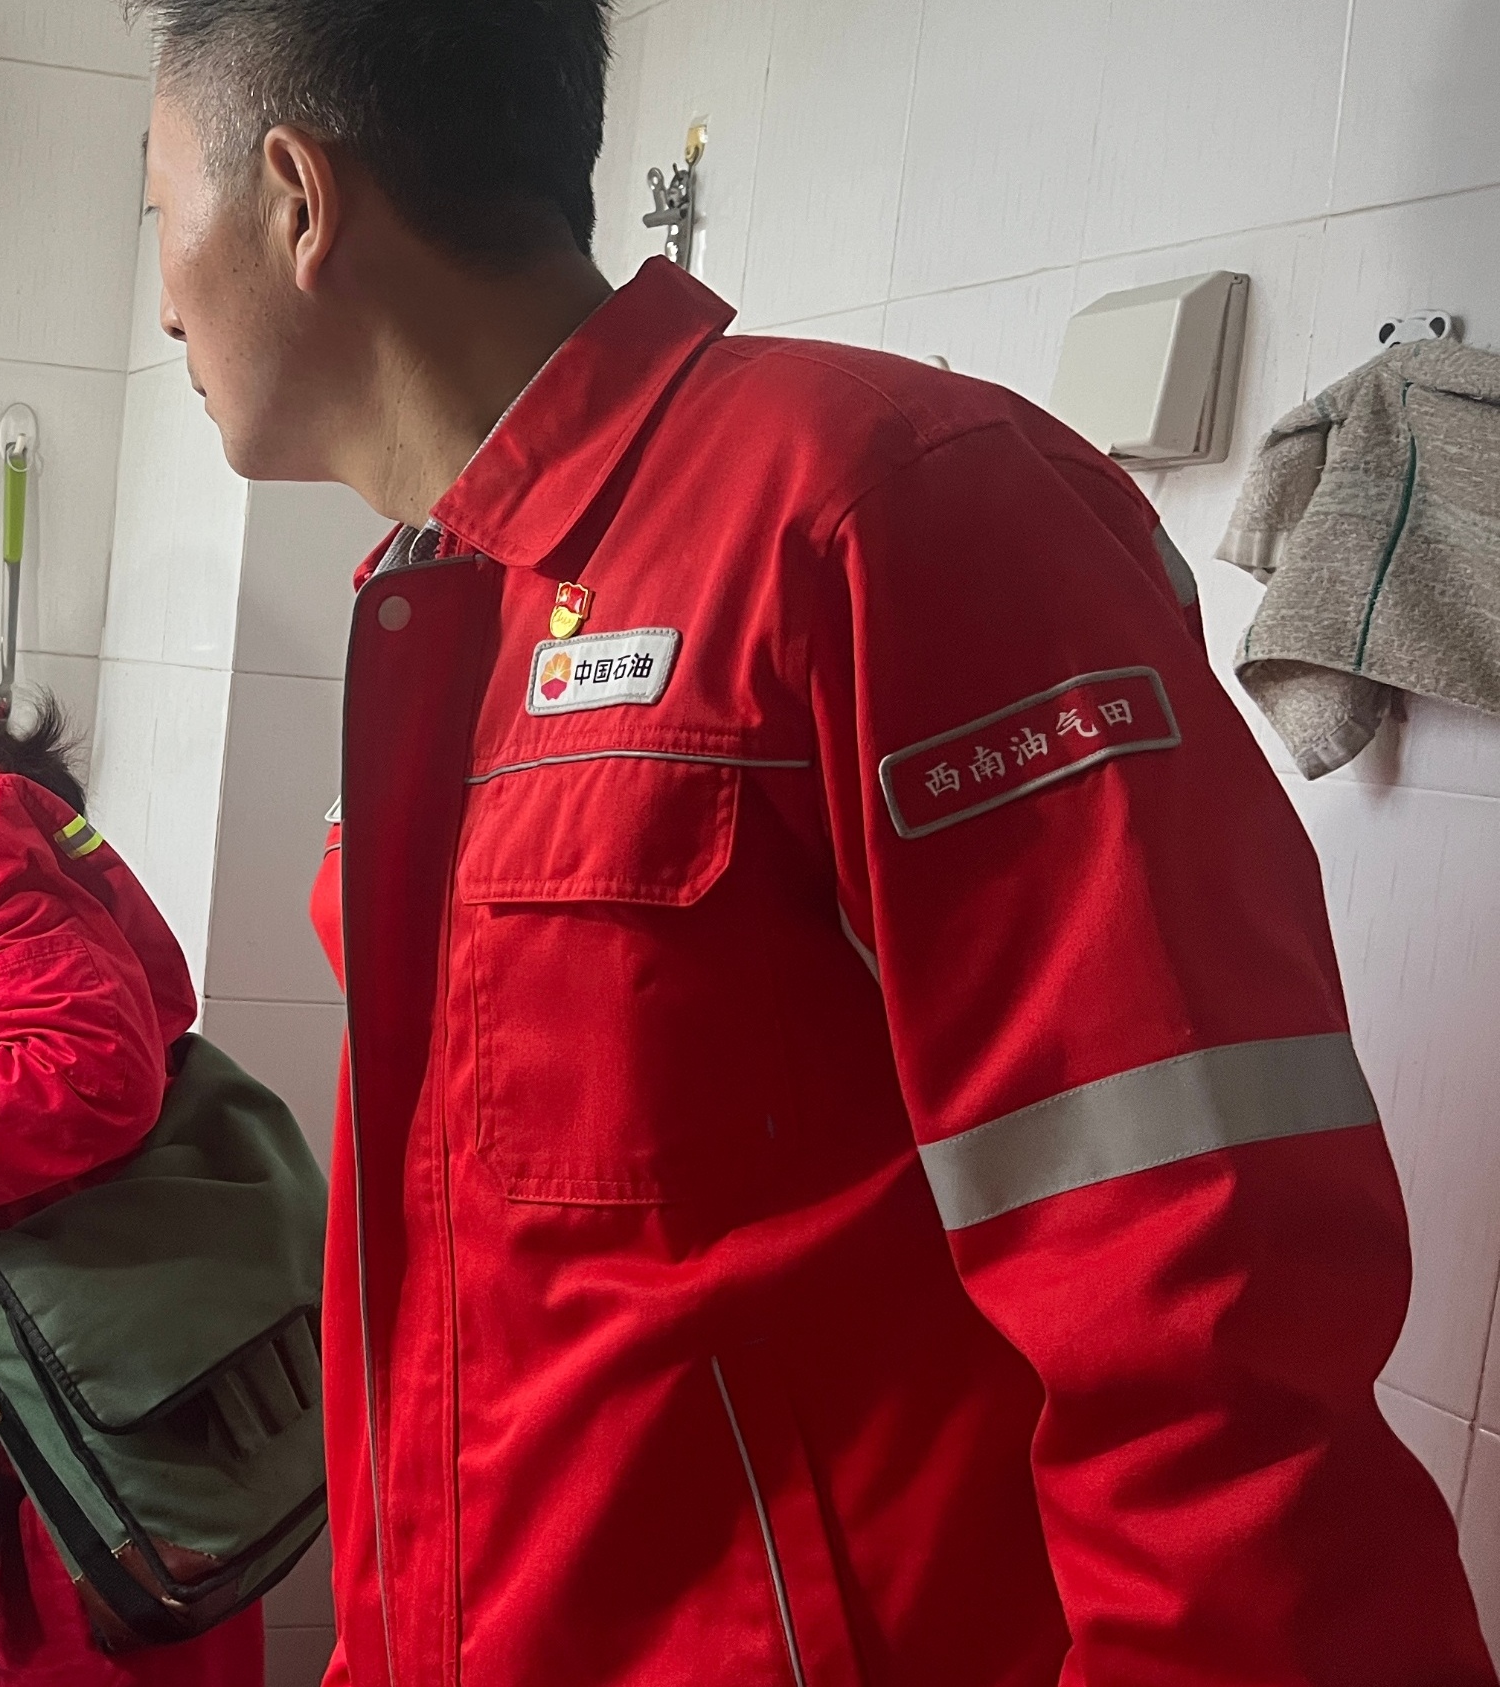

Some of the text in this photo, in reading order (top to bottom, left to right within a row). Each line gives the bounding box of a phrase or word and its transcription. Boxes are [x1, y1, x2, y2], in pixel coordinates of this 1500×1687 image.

[574, 653, 654, 686] 中国石油
[924, 699, 1133, 797] 西南油气田
